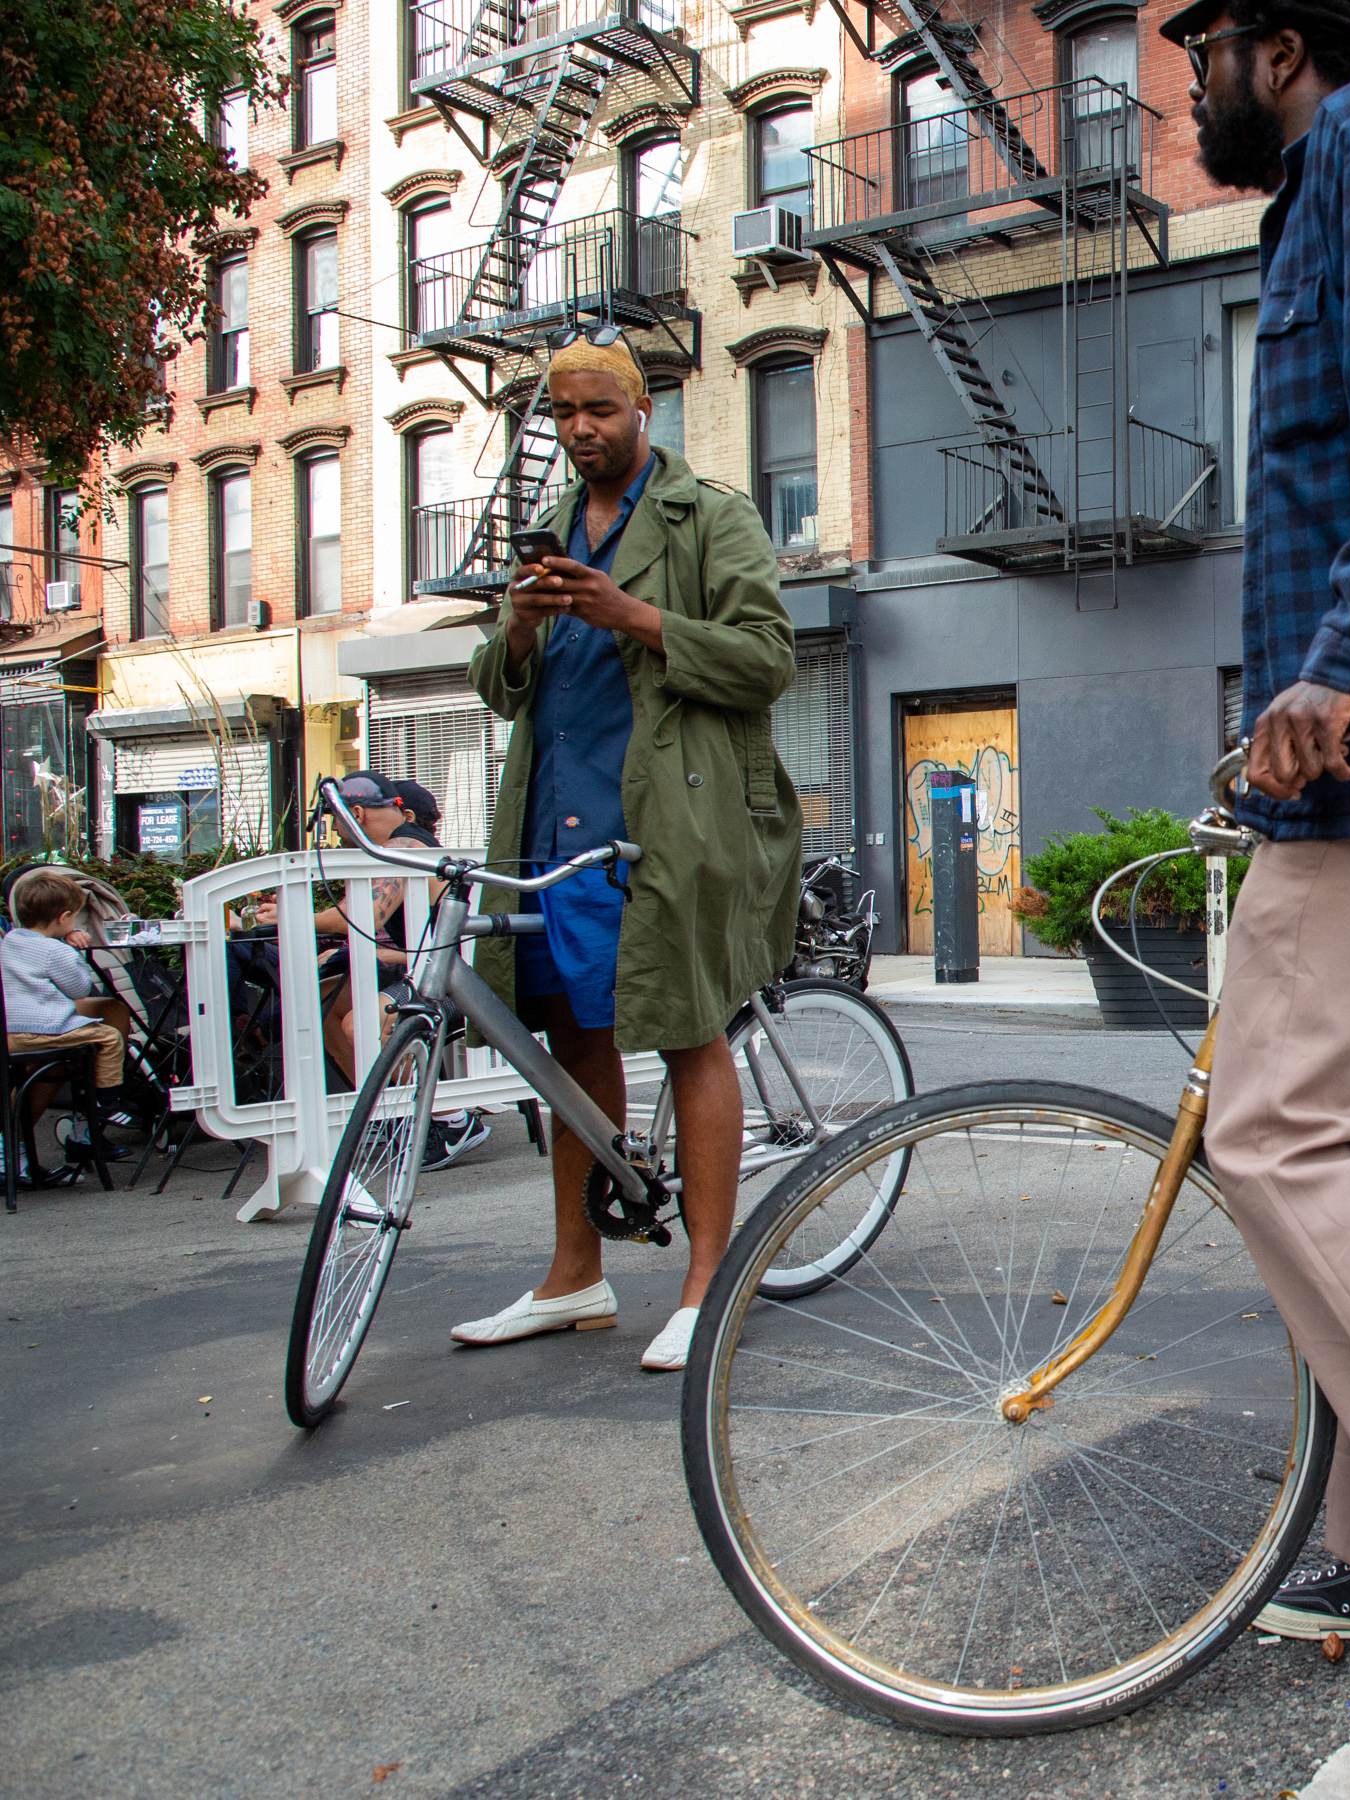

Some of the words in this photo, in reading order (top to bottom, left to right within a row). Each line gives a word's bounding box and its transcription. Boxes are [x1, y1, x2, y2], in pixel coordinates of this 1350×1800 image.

[141, 816, 154, 825] FOR
[156, 815, 178, 825] LEASE
[977, 875, 1010, 902] BLM
[868, 1112, 919, 1140] 37-590
[1231, 1549, 1280, 1621] SCHWALBE
[1105, 1659, 1184, 1707] MARATHON
